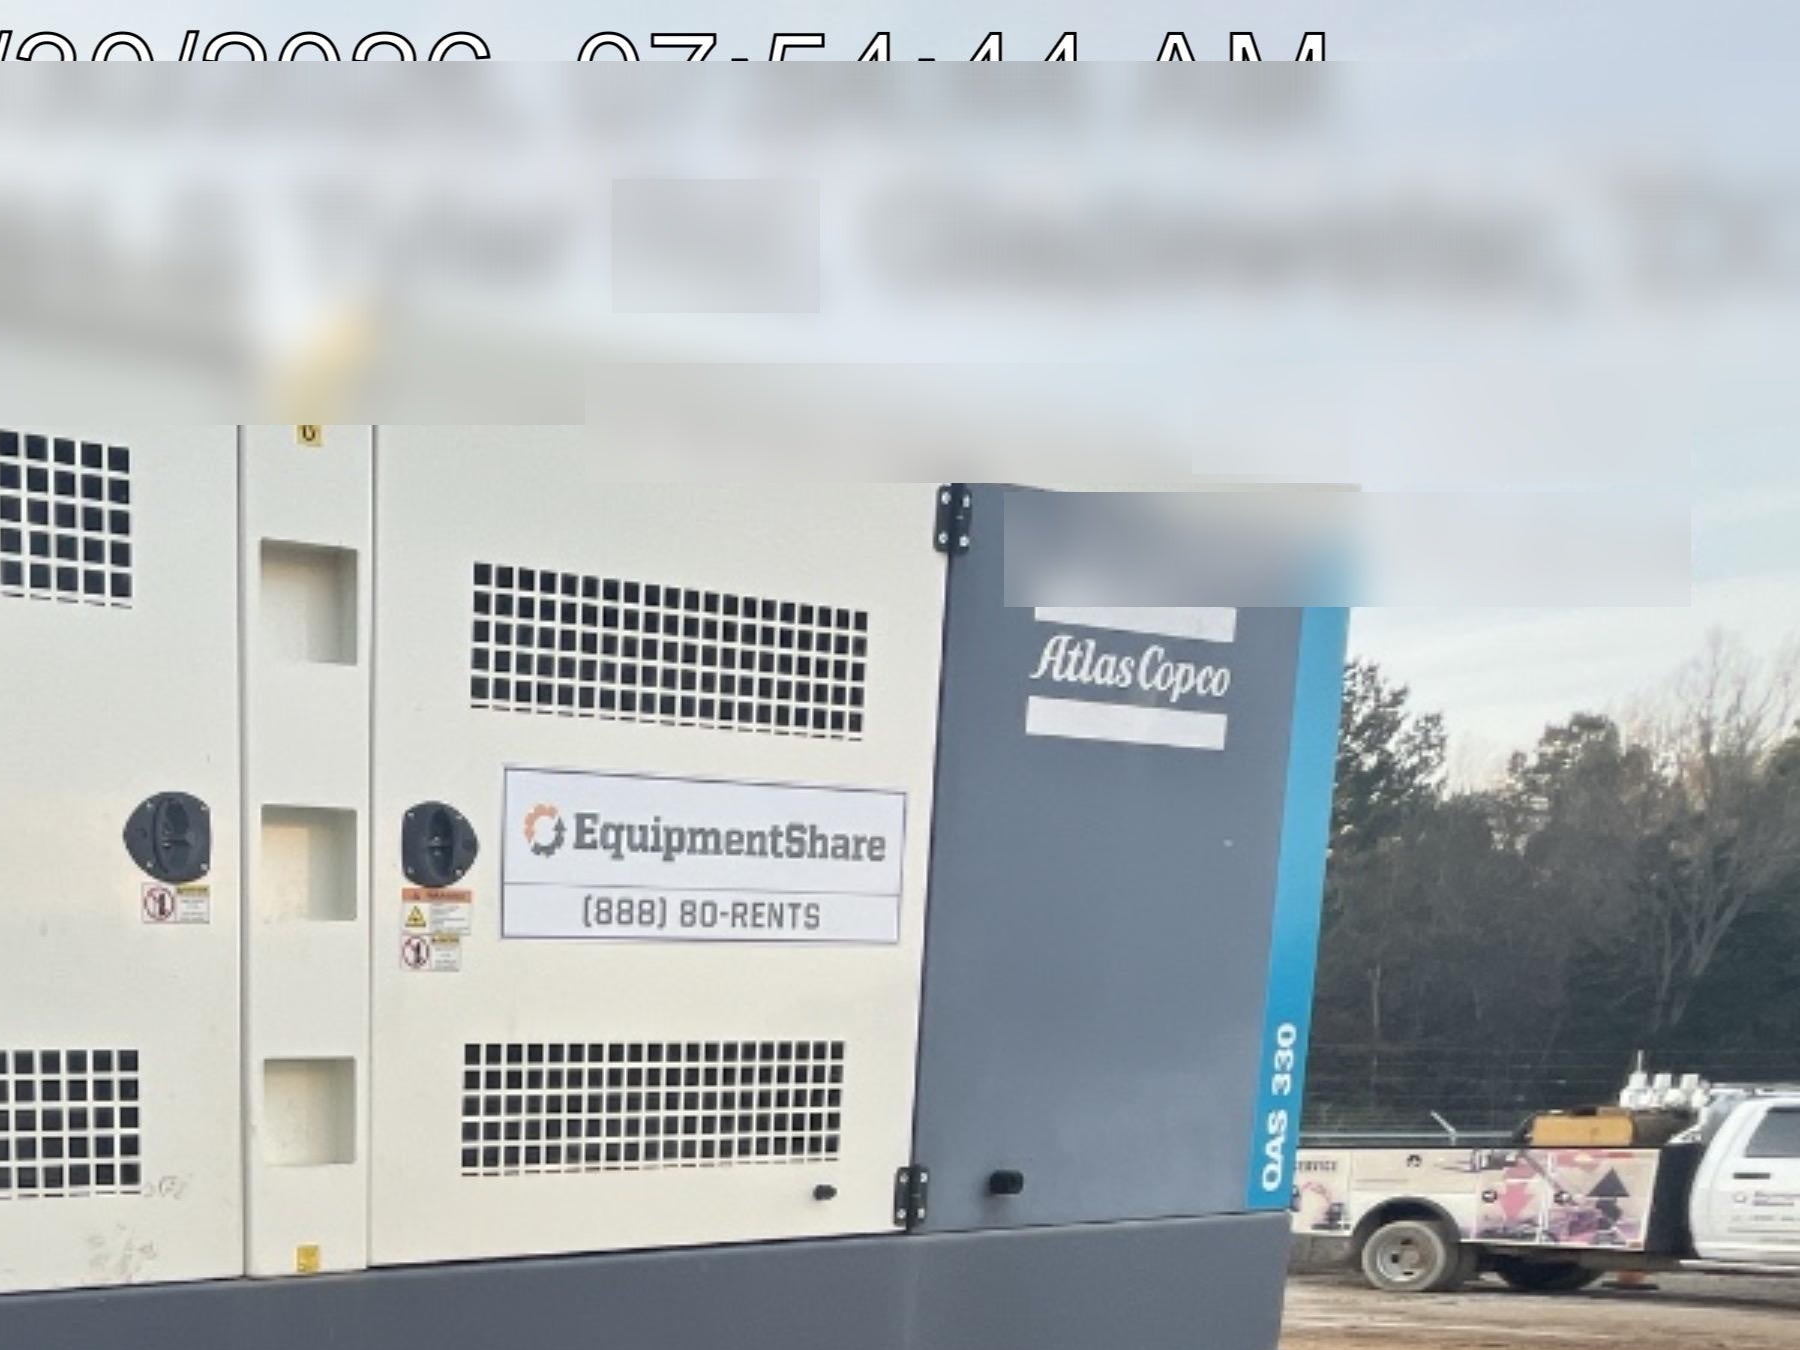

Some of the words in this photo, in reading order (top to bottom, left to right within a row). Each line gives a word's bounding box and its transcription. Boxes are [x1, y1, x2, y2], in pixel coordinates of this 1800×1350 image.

[1029, 634, 1135, 688] Atlas
[1137, 644, 1231, 703] Copco
[573, 811, 886, 863] EquipmentShare
[582, 895, 667, 929] (888)
[680, 900, 821, 931] 80-RENTS
[1272, 1023, 1297, 1096] 330
[1261, 1108, 1288, 1192] QAS
